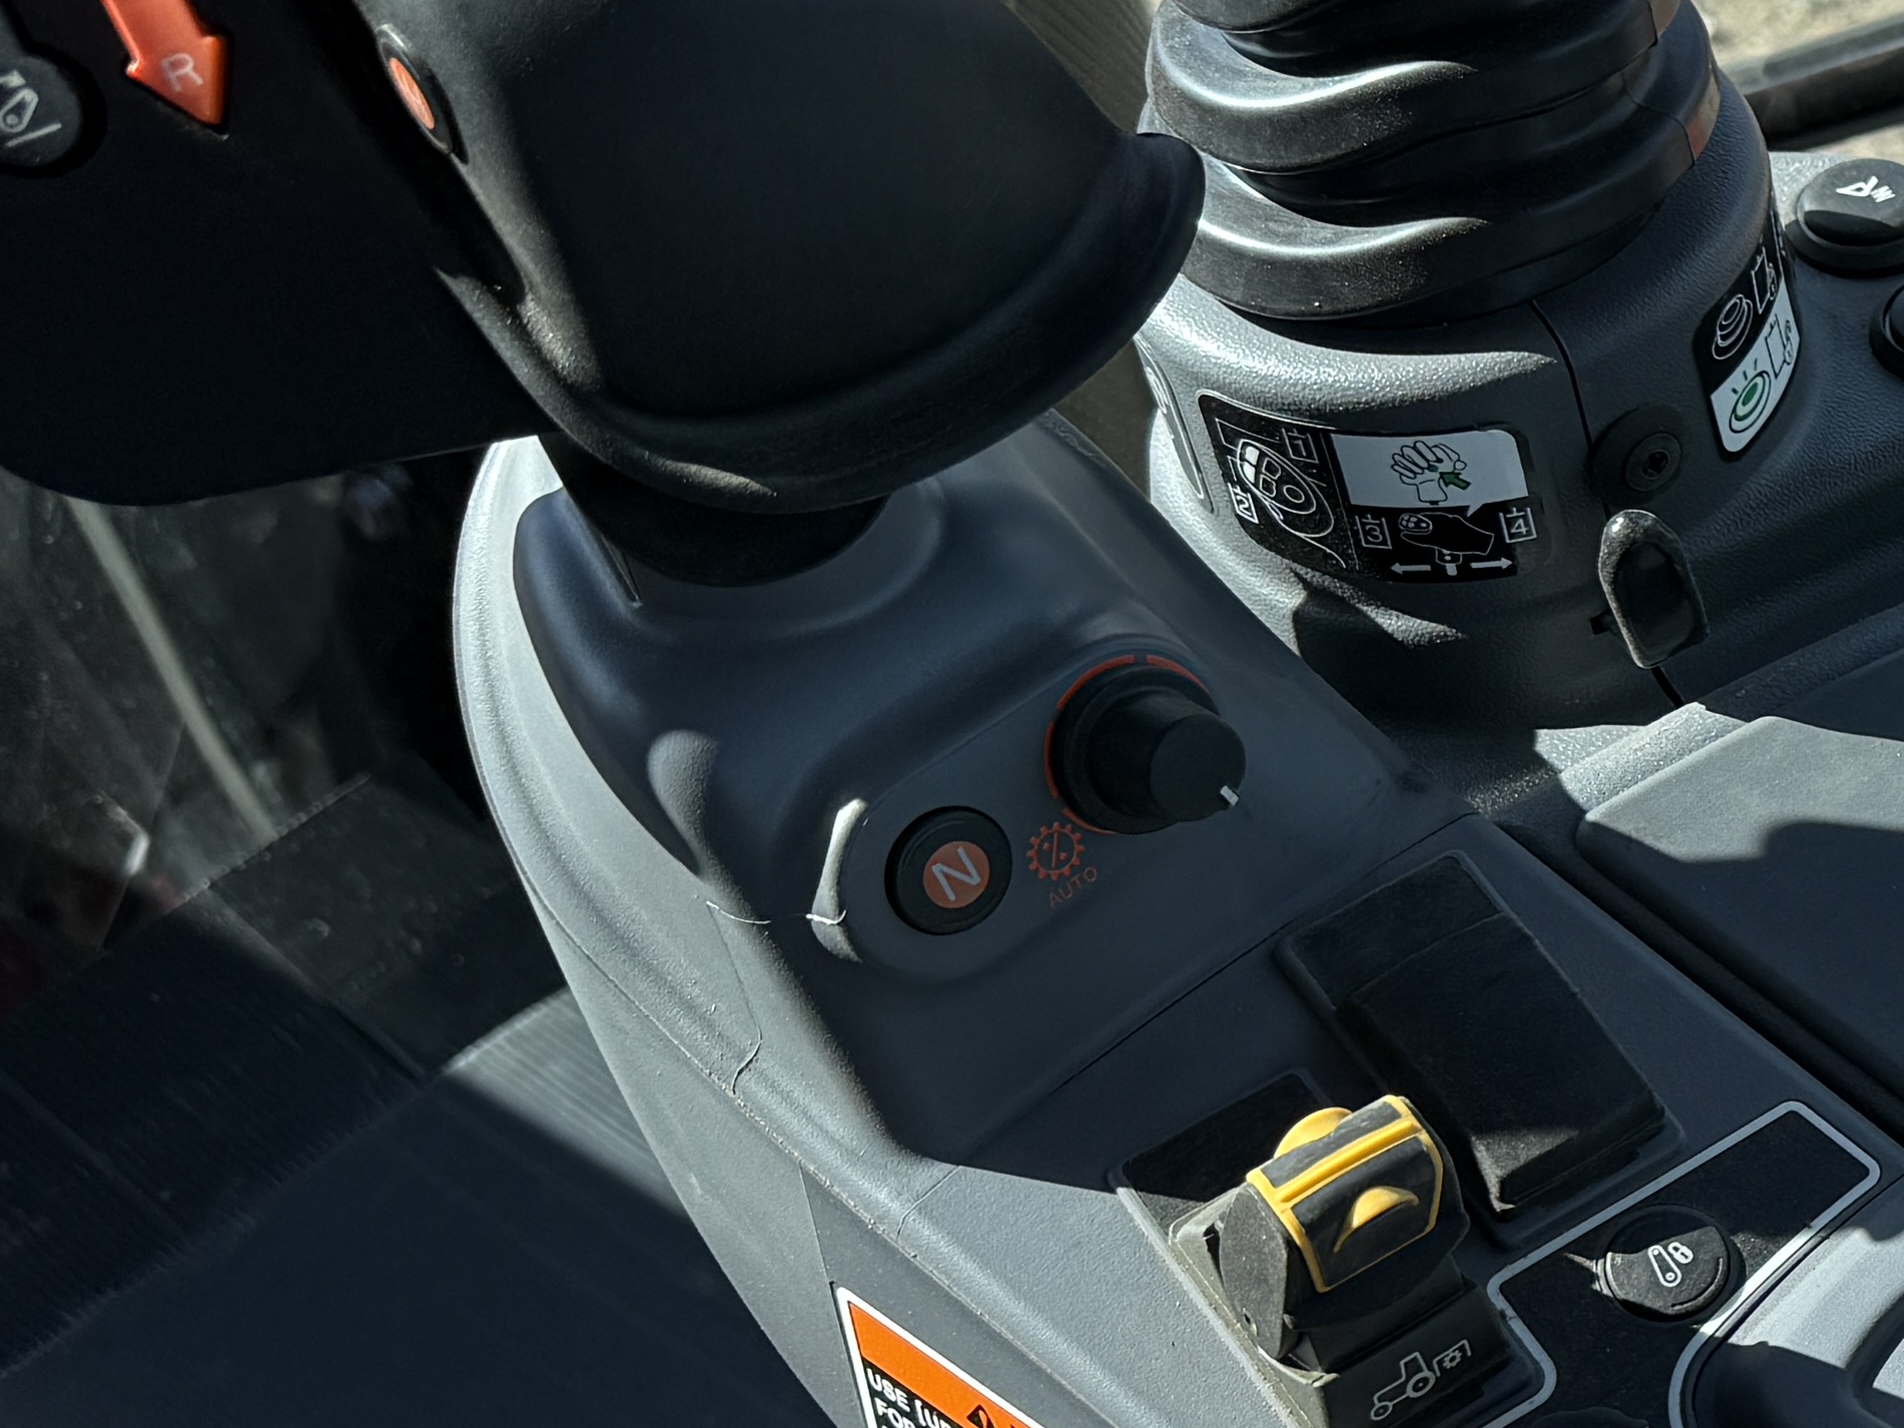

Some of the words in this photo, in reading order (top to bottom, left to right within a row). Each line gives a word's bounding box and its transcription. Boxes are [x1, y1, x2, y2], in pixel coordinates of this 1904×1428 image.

[161, 54, 203, 93] R
[934, 847, 981, 902] N
[1047, 866, 1098, 907] AUTO
[867, 1368, 910, 1412] USE
